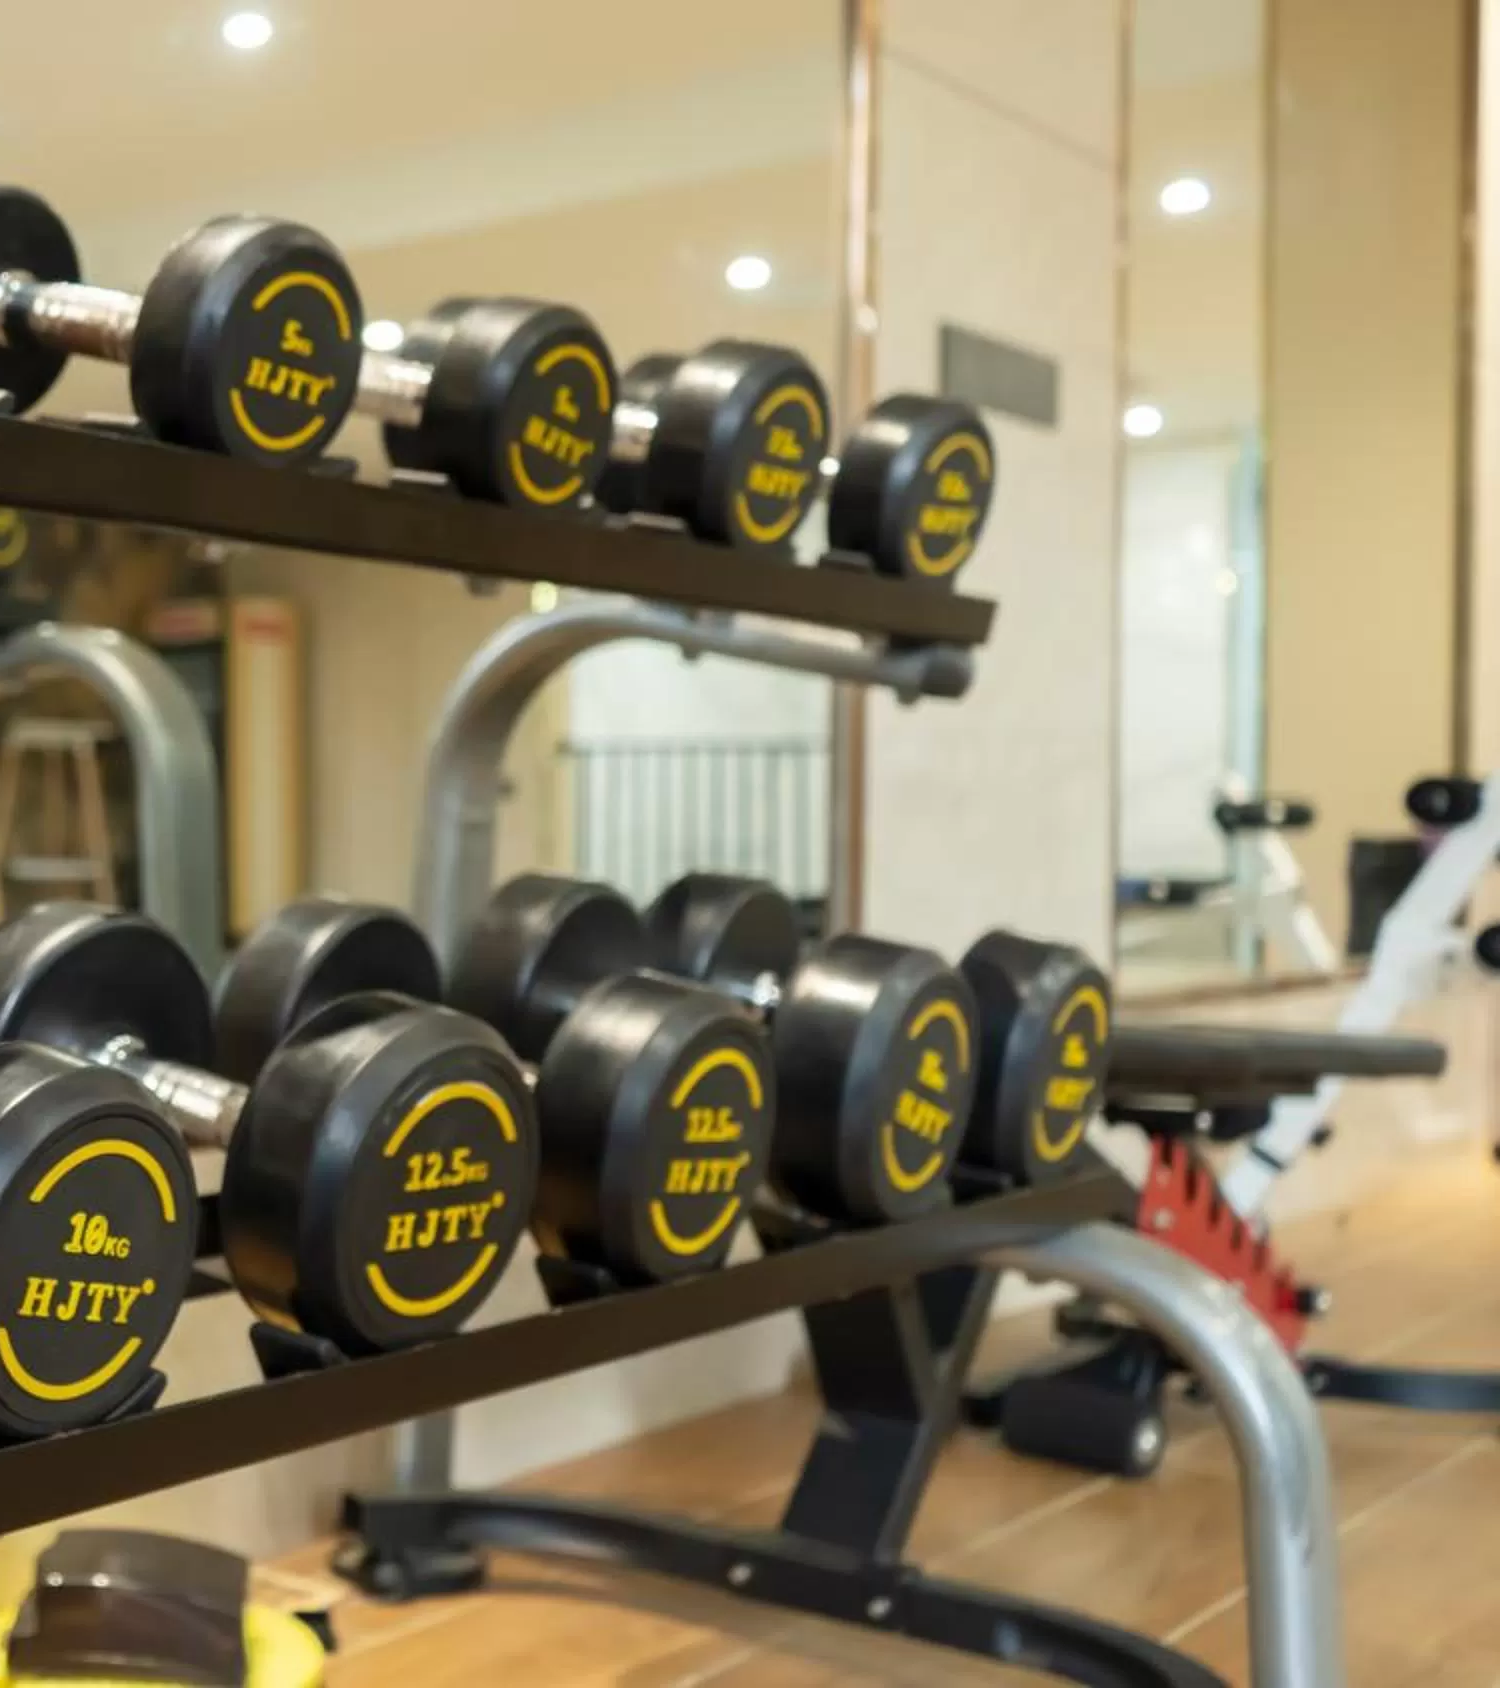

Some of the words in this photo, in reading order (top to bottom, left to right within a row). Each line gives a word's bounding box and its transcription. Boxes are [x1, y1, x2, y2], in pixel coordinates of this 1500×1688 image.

[63, 1212, 131, 1258] 10KG
[384, 1201, 492, 1252] HJTY
[17, 1276, 142, 1324] HJTY
